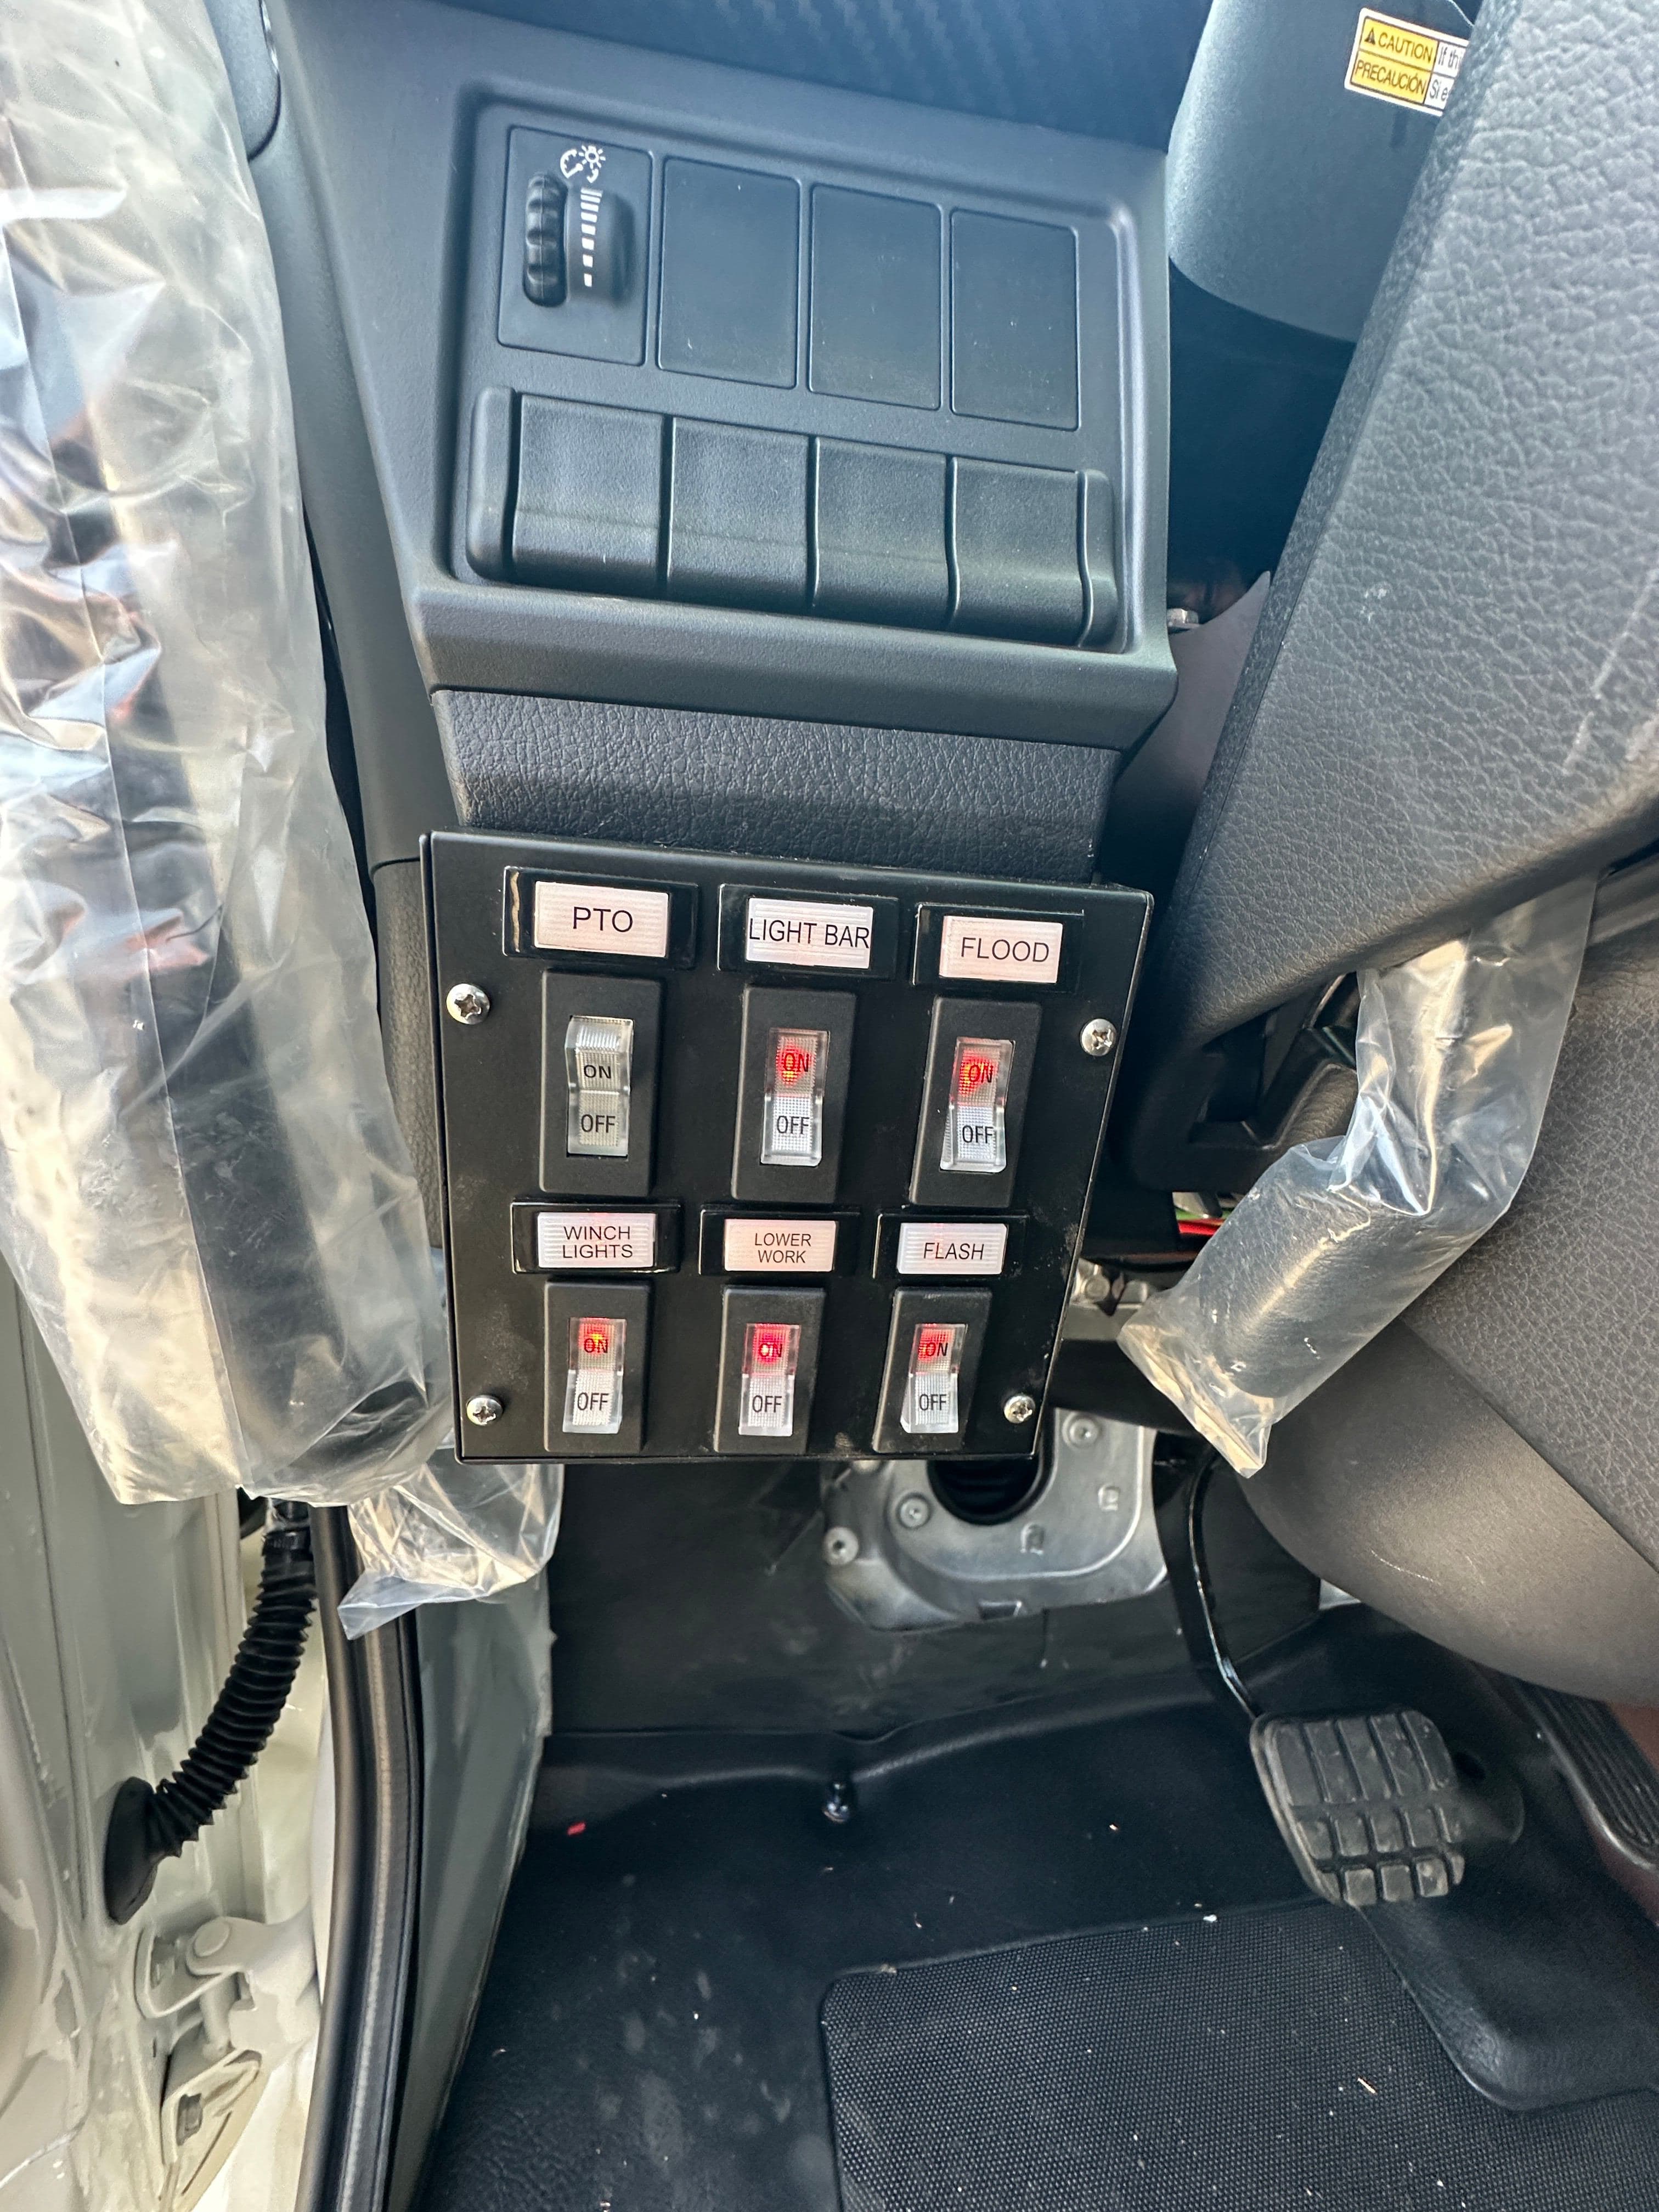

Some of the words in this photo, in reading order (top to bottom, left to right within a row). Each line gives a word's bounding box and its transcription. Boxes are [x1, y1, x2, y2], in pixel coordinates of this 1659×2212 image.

[1378, 32, 1433, 64] CAUTION
[1438, 46, 1447, 66] If
[1355, 59, 1427, 95] PRECAUCIÓN
[572, 906, 634, 933] PTO
[749, 917, 816, 944] LIGHT
[825, 924, 870, 949] BAR
[961, 937, 1049, 963] FLOOD
[583, 1064, 612, 1080] ON
[782, 1053, 809, 1074] ON
[968, 1064, 992, 1084] ON
[580, 1114, 616, 1134] OFF
[776, 1115, 809, 1135] OFF
[962, 1125, 993, 1144] OFF
[563, 1225, 631, 1241] WINCH
[754, 1233, 811, 1248] LOWER
[562, 1243, 633, 1259] LIGHTS
[758, 1249, 806, 1264] WORK
[923, 1242, 985, 1260] FLASH
[583, 1338, 609, 1354] ON
[758, 1342, 783, 1359] ON
[925, 1342, 948, 1357] ON
[577, 1392, 609, 1412] OFF
[752, 1395, 783, 1413] OFF
[918, 1393, 947, 1411] OFF
